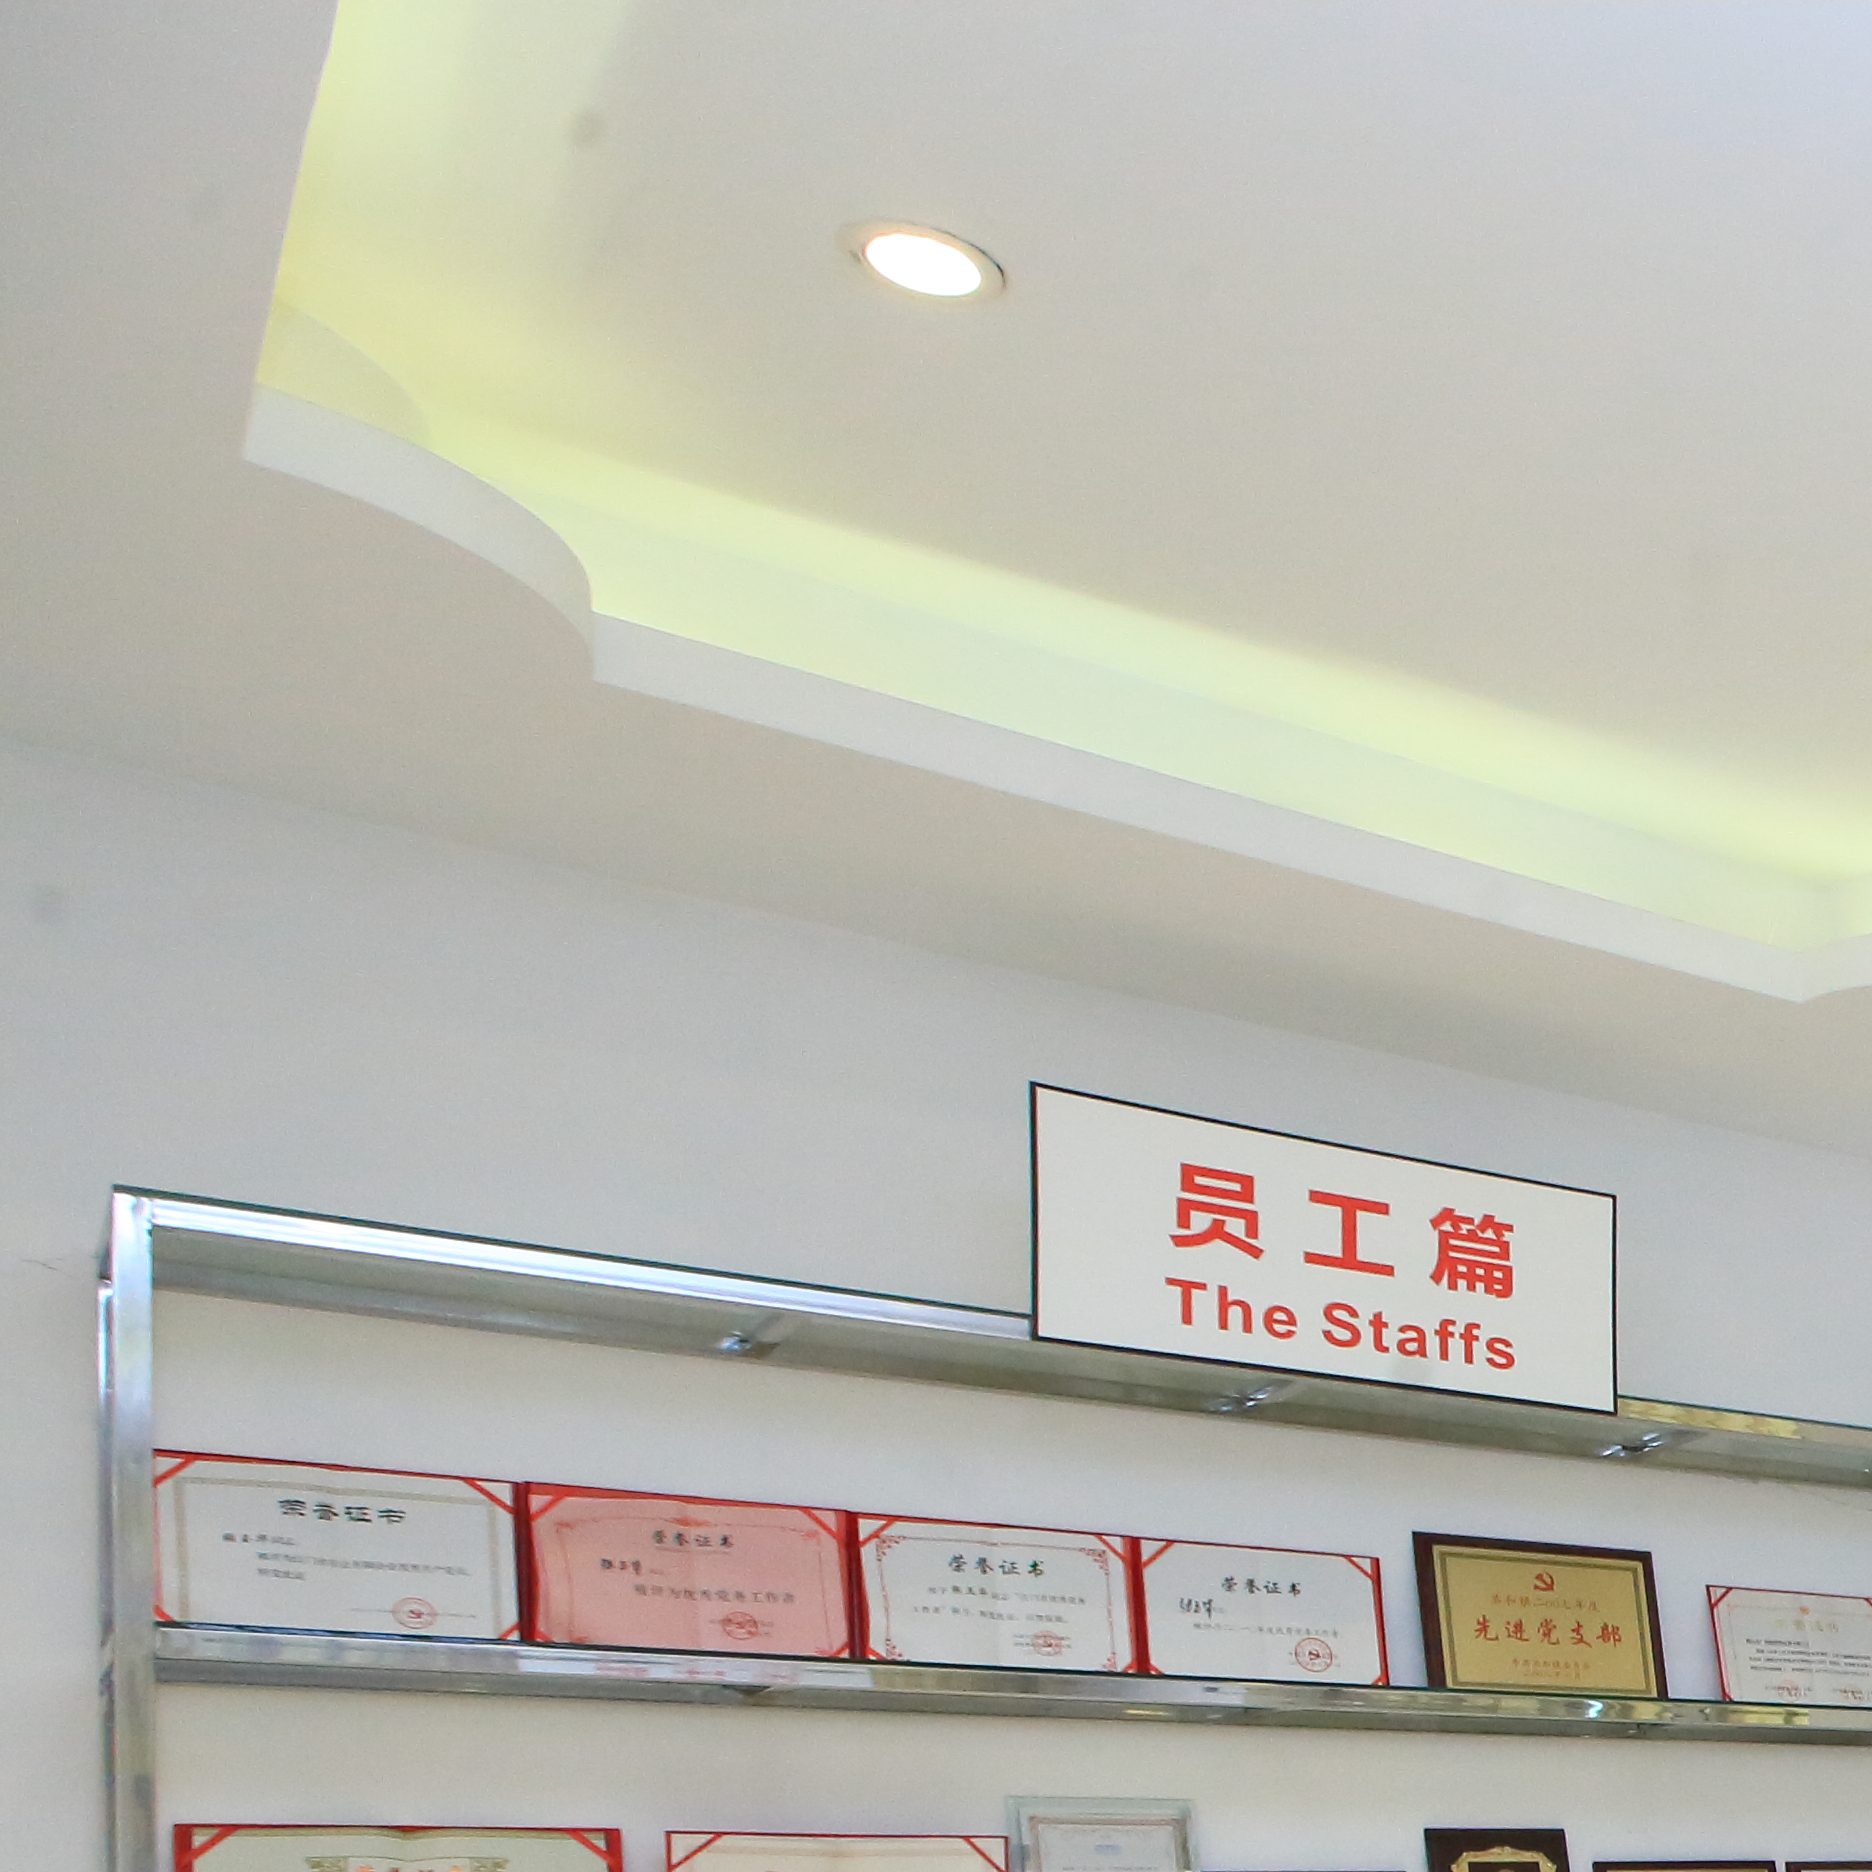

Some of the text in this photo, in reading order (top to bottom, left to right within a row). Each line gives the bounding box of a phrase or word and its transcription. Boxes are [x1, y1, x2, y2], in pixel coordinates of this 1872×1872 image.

[1169, 1162, 1517, 1300] 员工篇
[1165, 1276, 1517, 1372] The Staffs
[1473, 1614, 1623, 1648] 先进党支部
